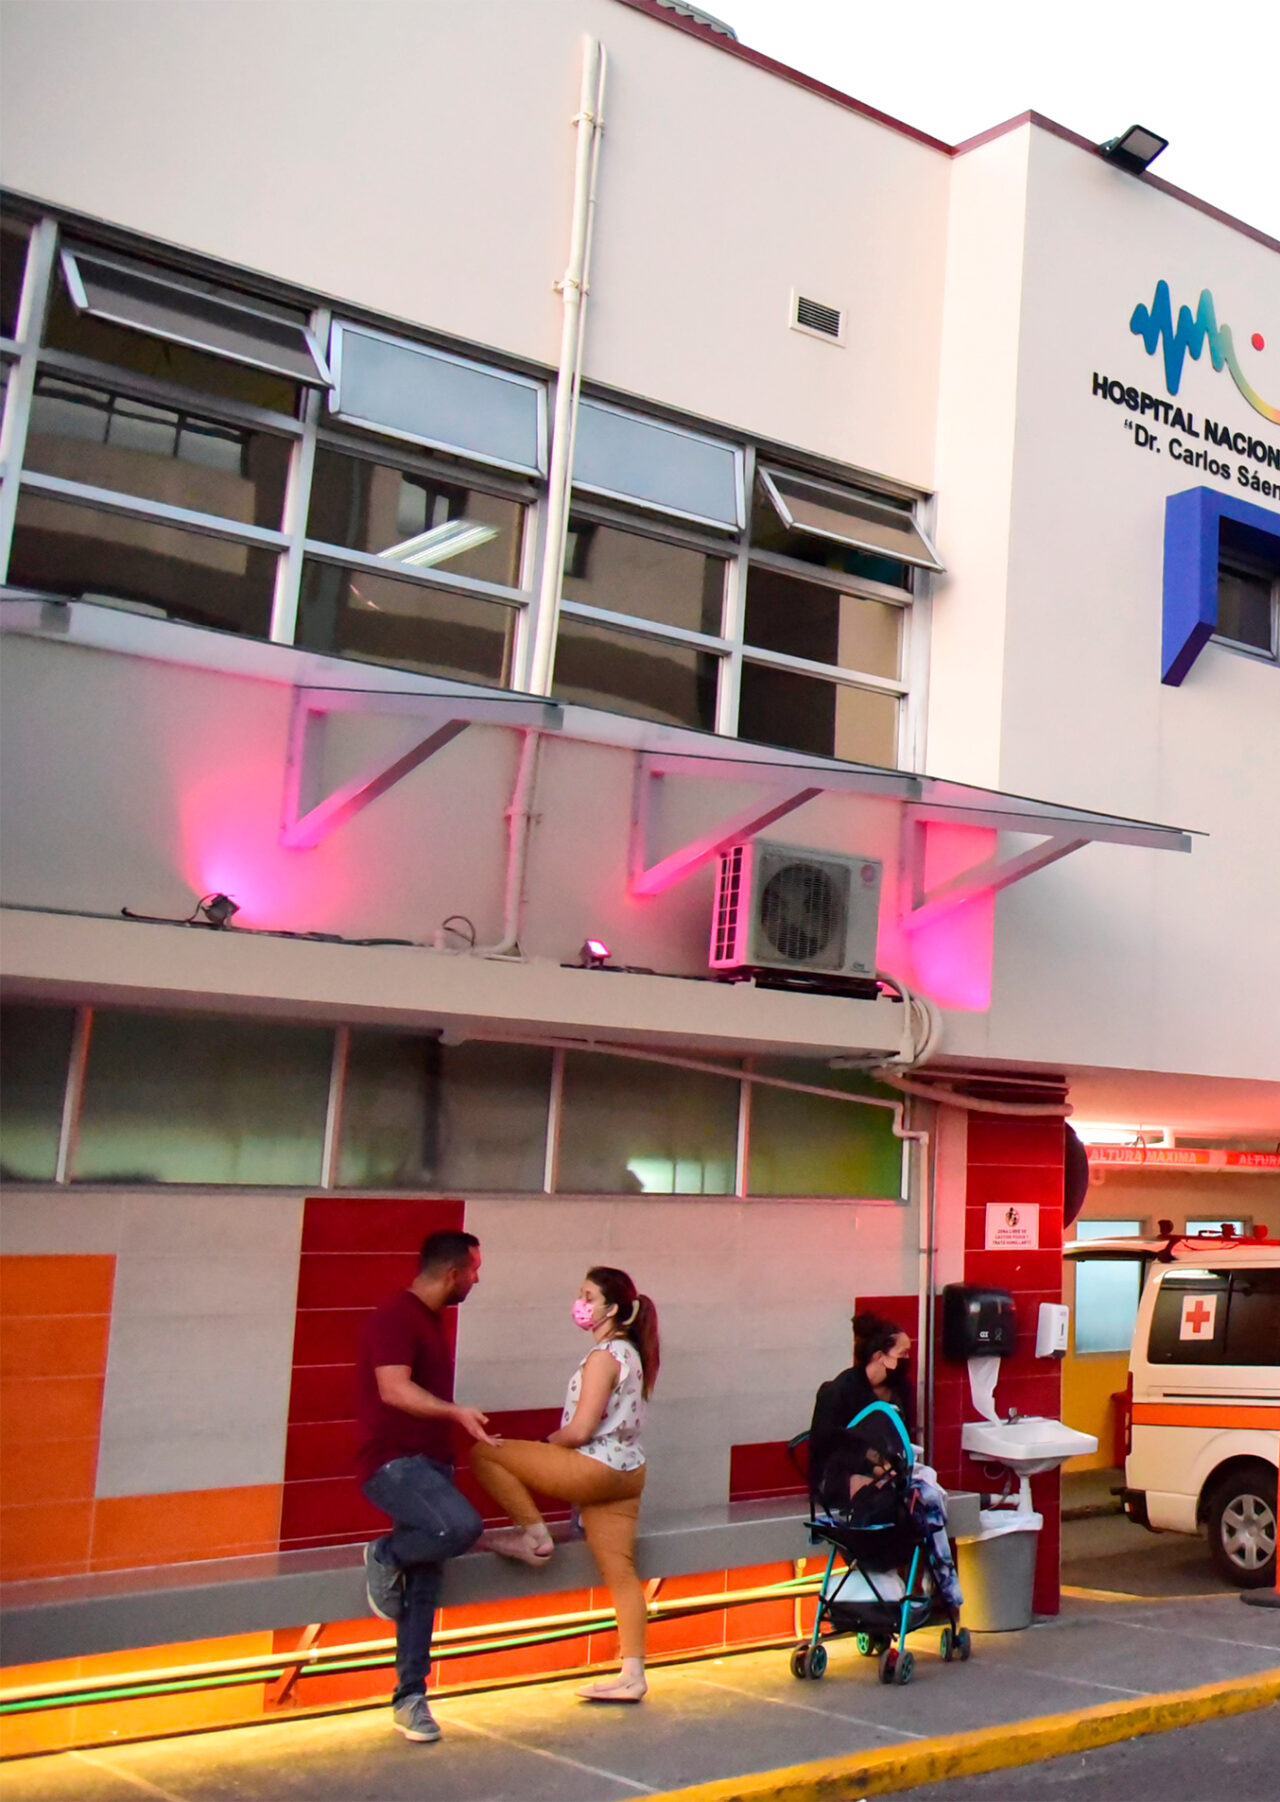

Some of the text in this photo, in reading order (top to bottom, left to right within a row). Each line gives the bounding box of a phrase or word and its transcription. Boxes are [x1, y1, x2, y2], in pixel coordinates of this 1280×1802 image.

[1092, 372, 1199, 438] HOSPITAL
[1168, 437, 1232, 481] Carlos
[1090, 1147, 1197, 1164] ALTURA MAXIMA
